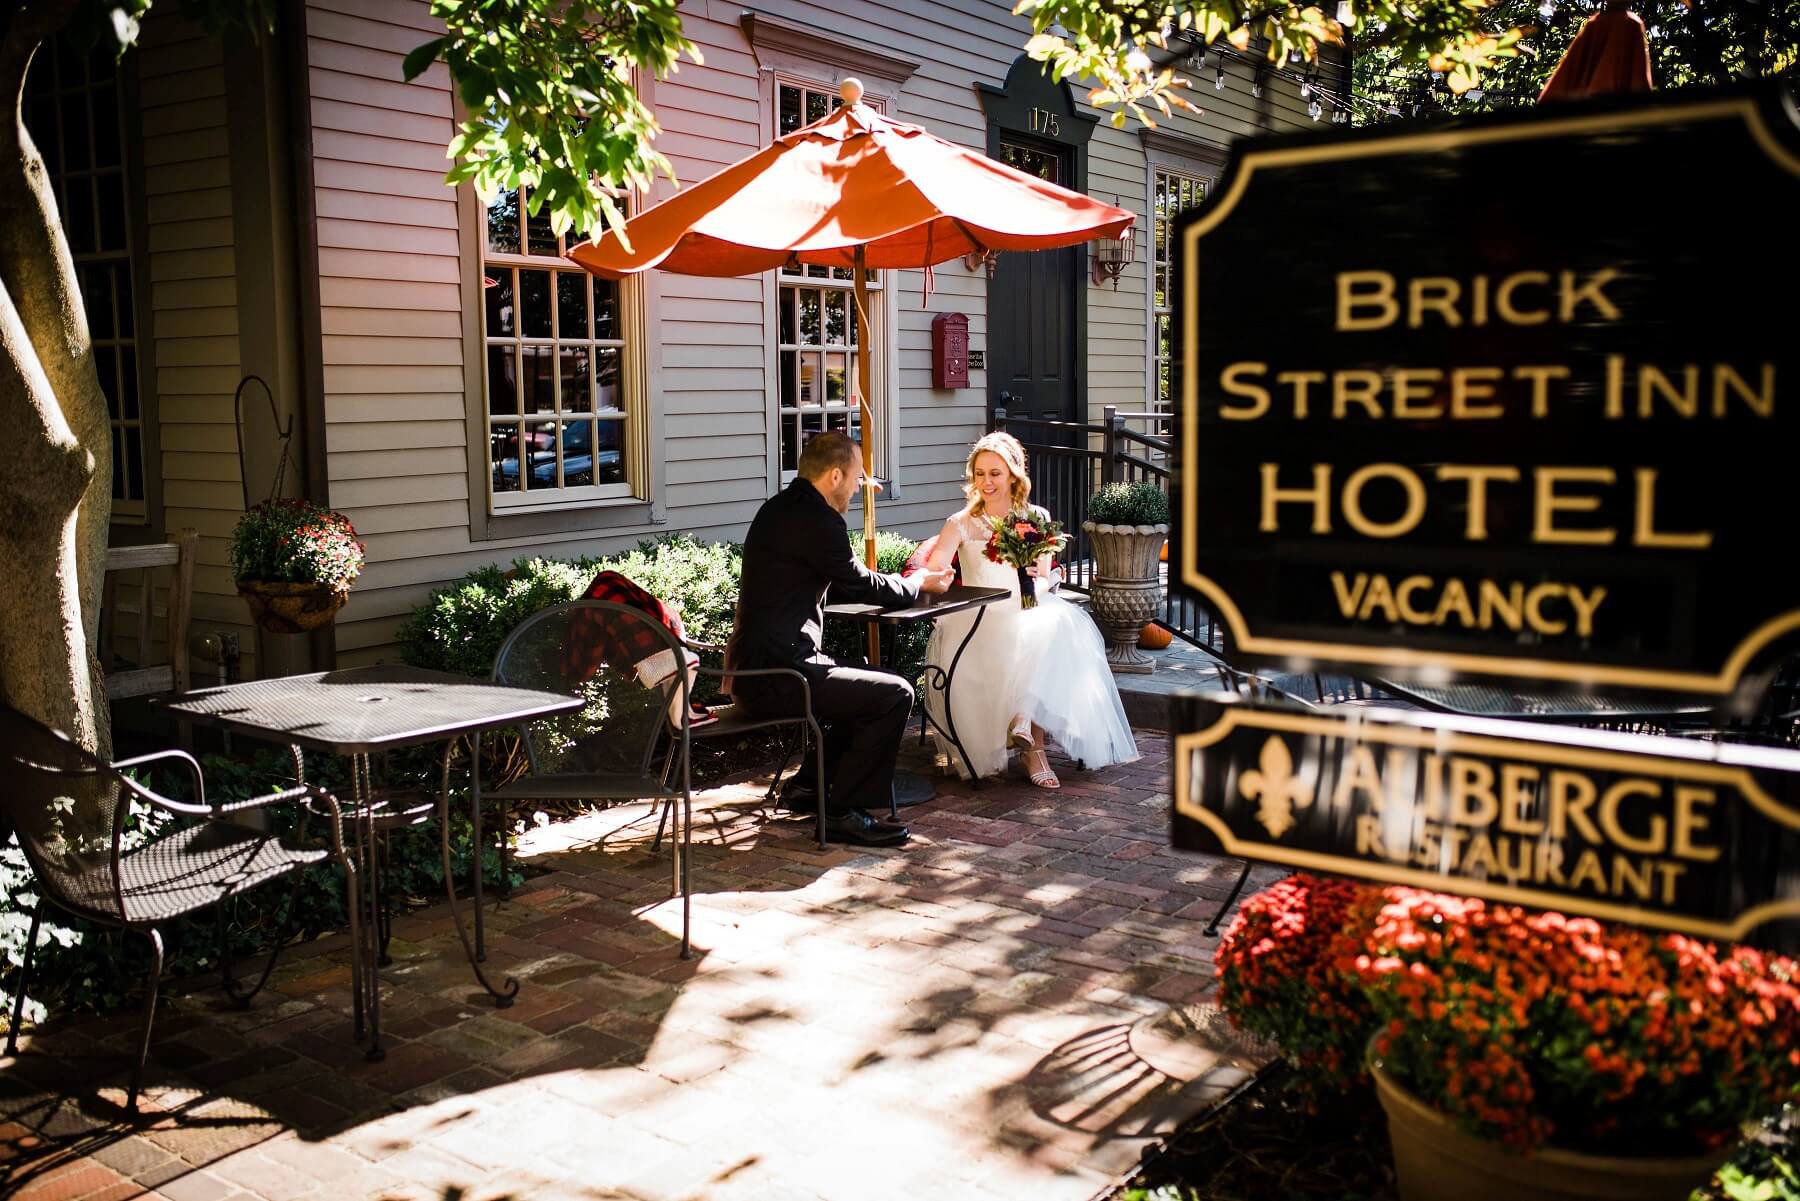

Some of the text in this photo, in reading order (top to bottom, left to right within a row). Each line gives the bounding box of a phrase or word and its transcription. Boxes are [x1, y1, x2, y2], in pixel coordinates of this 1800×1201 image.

[1031, 106, 1059, 136] 175
[1335, 268, 1624, 331] BRICK
[1219, 354, 1775, 419] STREET INN
[1259, 463, 1713, 547] HOTEL
[1331, 571, 1606, 637] VACANCY
[1332, 745, 1720, 862] AUBERGE
[1355, 814, 1687, 904] RSTAURANT
